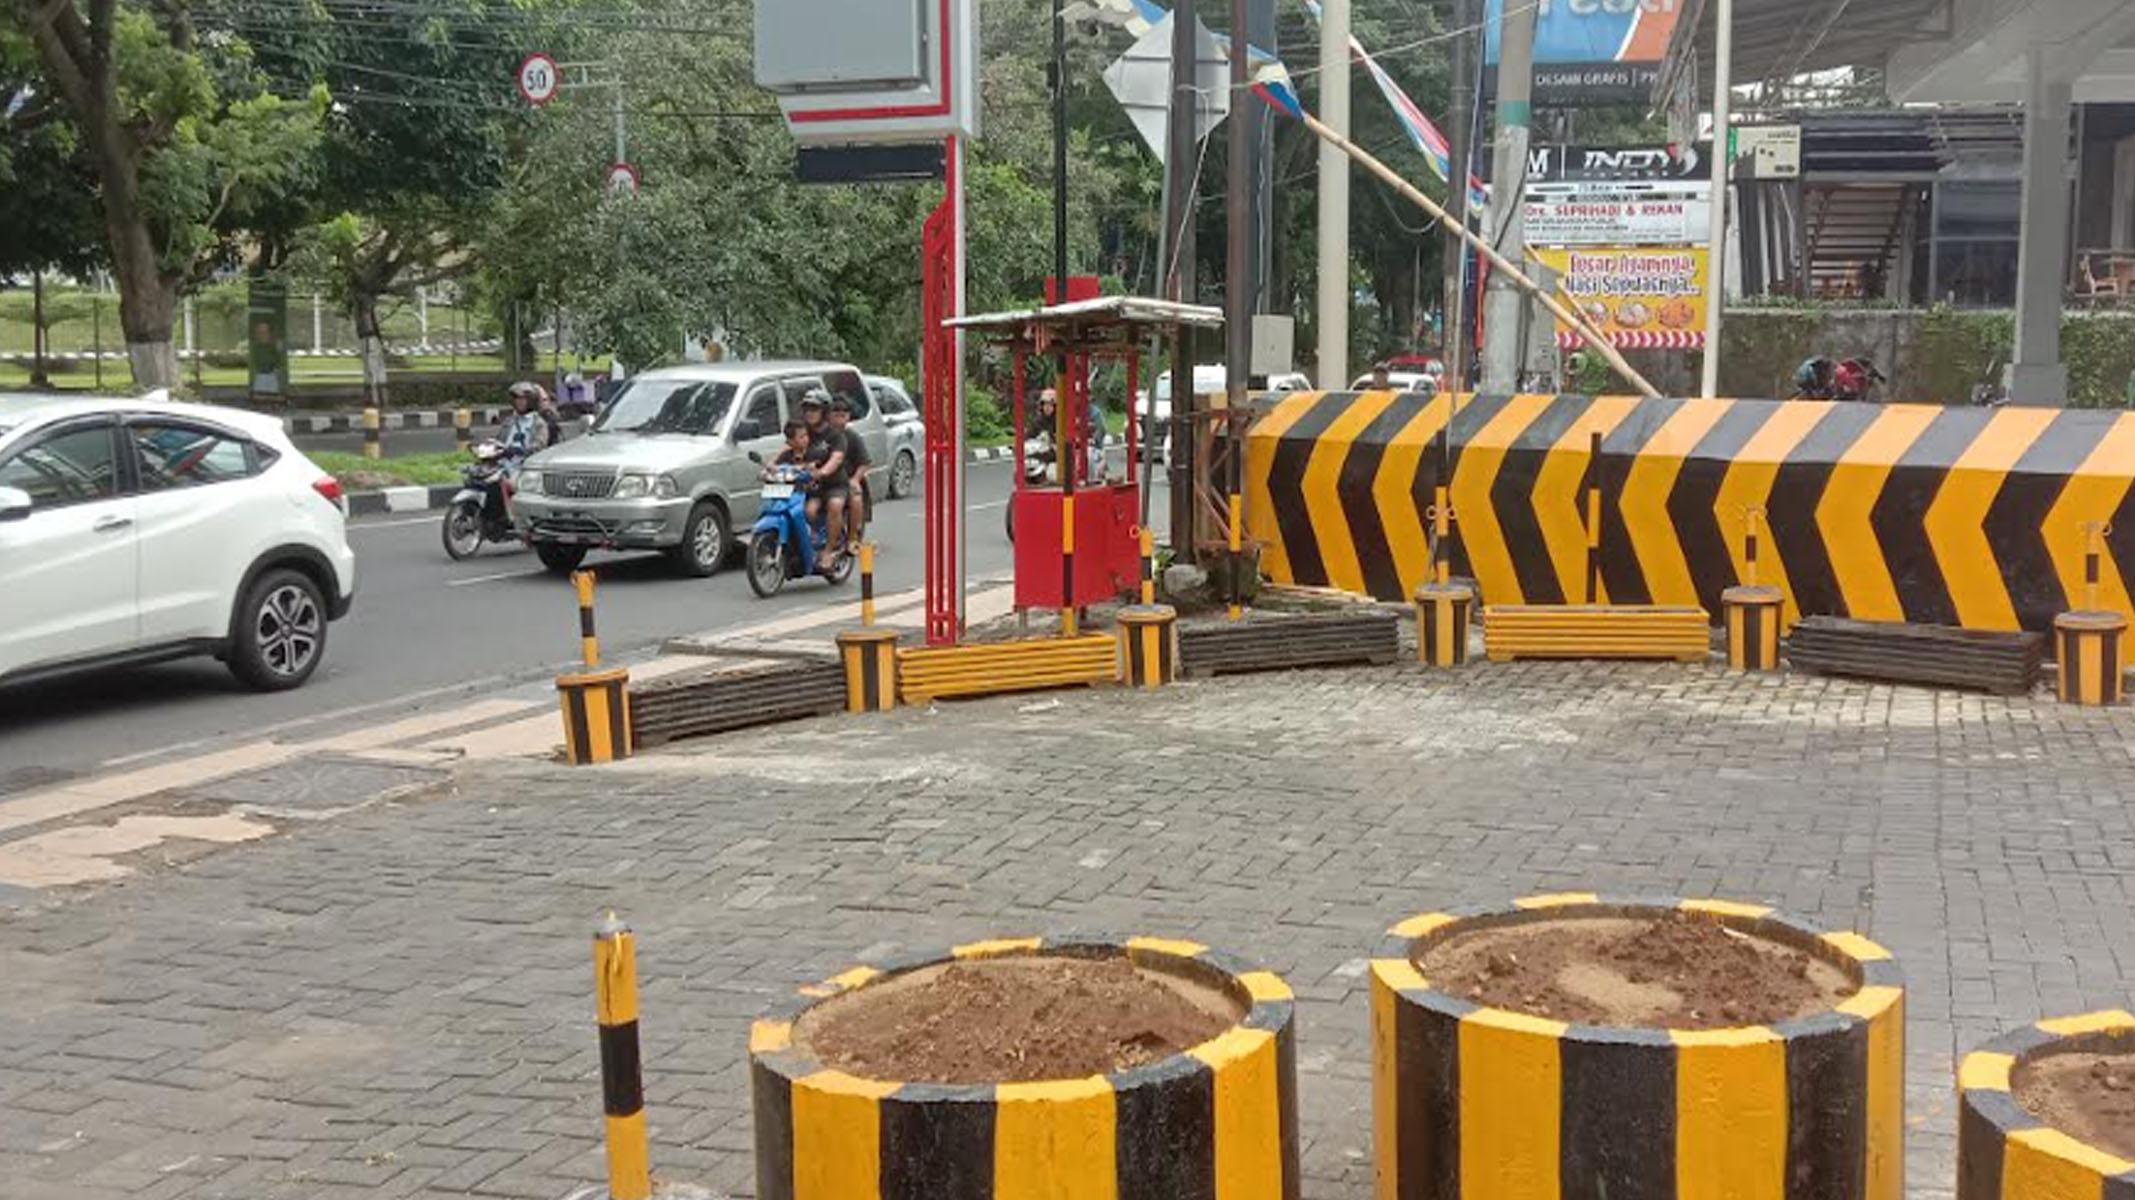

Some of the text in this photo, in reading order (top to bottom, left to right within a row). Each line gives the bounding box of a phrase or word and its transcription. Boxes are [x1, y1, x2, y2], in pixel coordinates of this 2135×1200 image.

[526, 70, 546, 90] 50
[1536, 75, 1581, 86] DESAIN
[1583, 74, 1629, 85] GRAFIS
[1626, 204, 1636, 215] &
